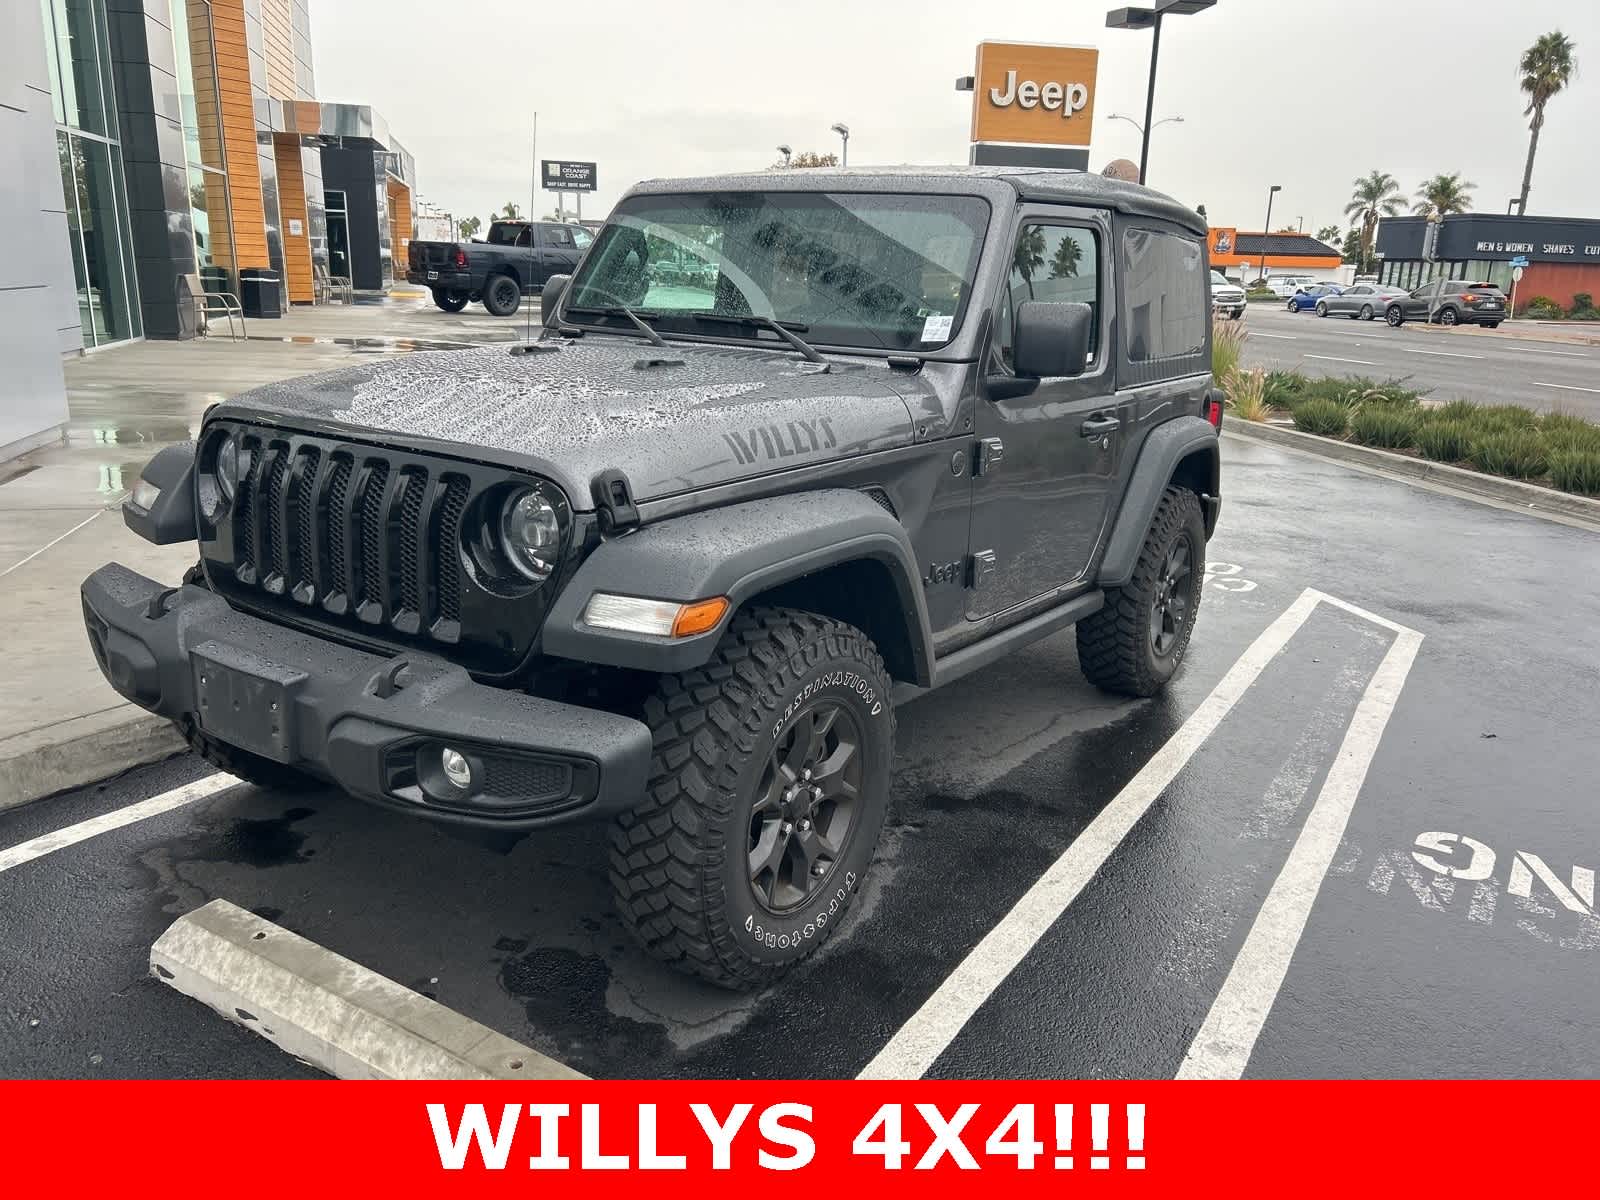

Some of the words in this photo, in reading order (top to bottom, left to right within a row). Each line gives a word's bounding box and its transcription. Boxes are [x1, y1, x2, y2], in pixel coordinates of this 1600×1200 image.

[990, 70, 1088, 118] Jeep
[1476, 241, 1495, 252] MEN
[1496, 242, 1503, 252] &
[1505, 243, 1534, 253] WOMEN
[1542, 244, 1575, 254] SHAVES
[721, 417, 837, 464] WILLYS
[923, 560, 961, 586] Jeep
[772, 671, 876, 739] DESTINATION
